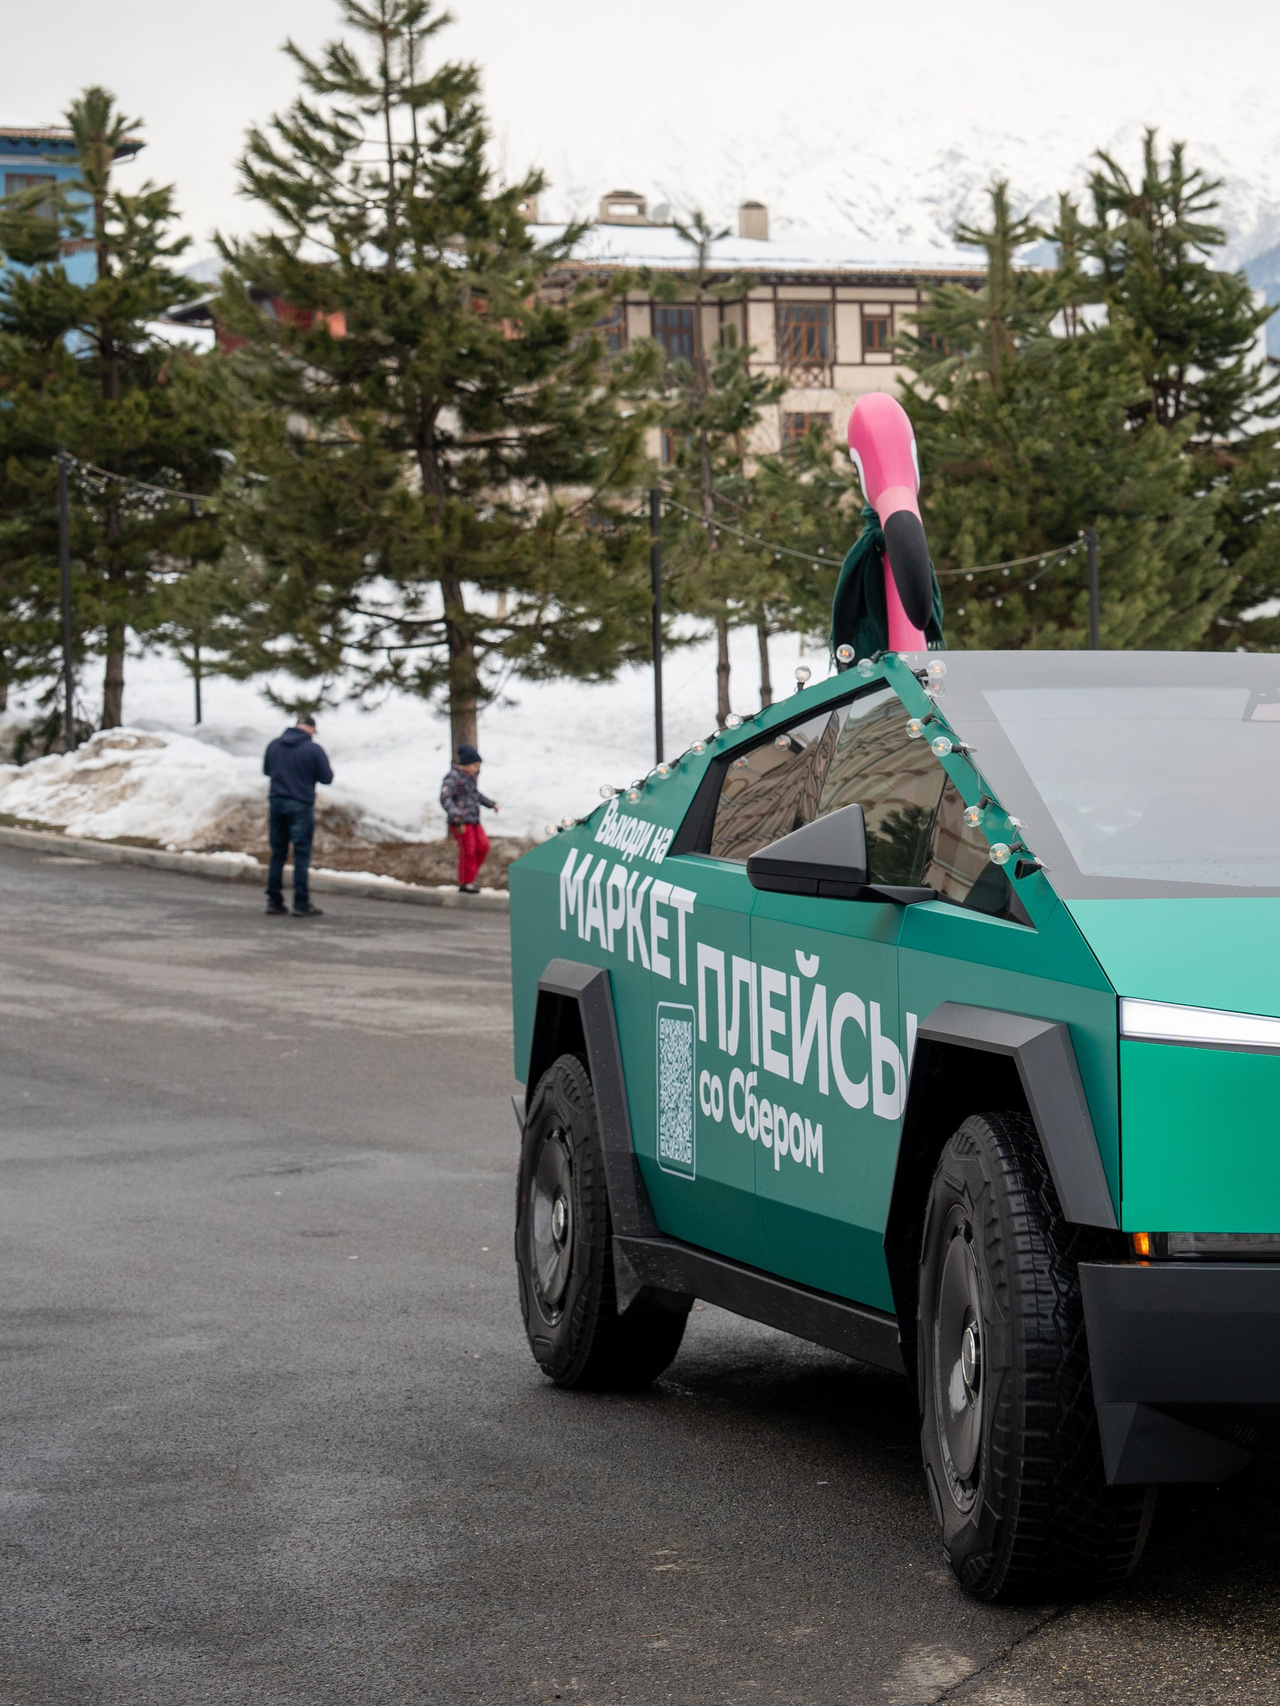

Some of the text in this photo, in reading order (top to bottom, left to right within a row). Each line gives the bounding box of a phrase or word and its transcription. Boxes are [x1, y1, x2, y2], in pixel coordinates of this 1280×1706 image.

[594, 798, 674, 864] Выходи на
[560, 847, 697, 986] МАРКЕТ
[699, 1067, 824, 1174] со Сбером
